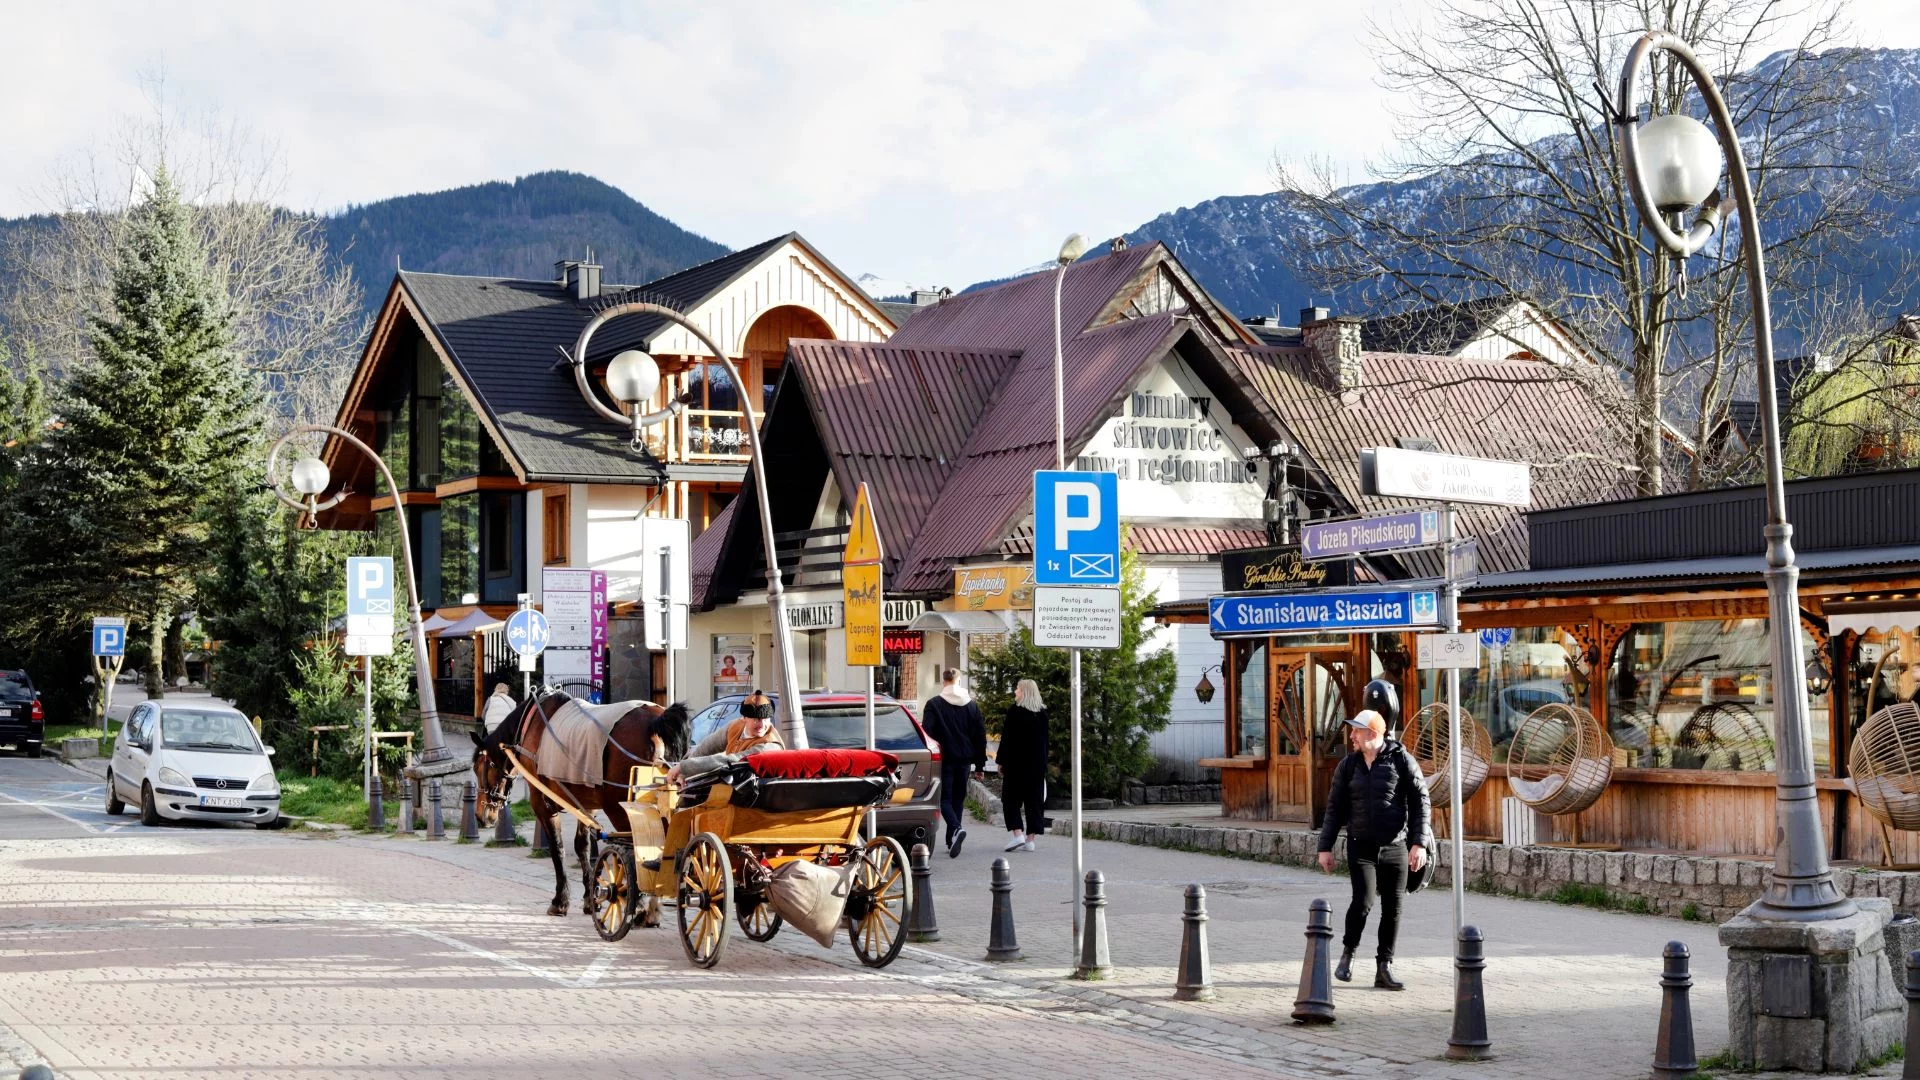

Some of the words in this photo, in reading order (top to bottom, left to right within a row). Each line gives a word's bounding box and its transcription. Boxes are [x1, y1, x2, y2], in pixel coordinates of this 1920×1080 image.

[1132, 390, 1211, 423] bimbry
[1138, 454, 1258, 485] regionalne
[1055, 481, 1101, 550] P
[1317, 530, 1348, 550] Józefa
[1351, 522, 1416, 546] Piłsudskiego
[1047, 560, 1060, 571] 1x
[1243, 565, 1286, 589] Góralskie
[1287, 561, 1326, 584] Praliny
[358, 563, 383, 599] P
[786, 605, 833, 627] EGIONALNE
[884, 600, 921, 622] OHOL
[1237, 601, 1329, 625] Stanisława
[1335, 598, 1402, 621] Staszica
[101, 629, 118, 652] P
[594, 574, 604, 691] FRYZJER
